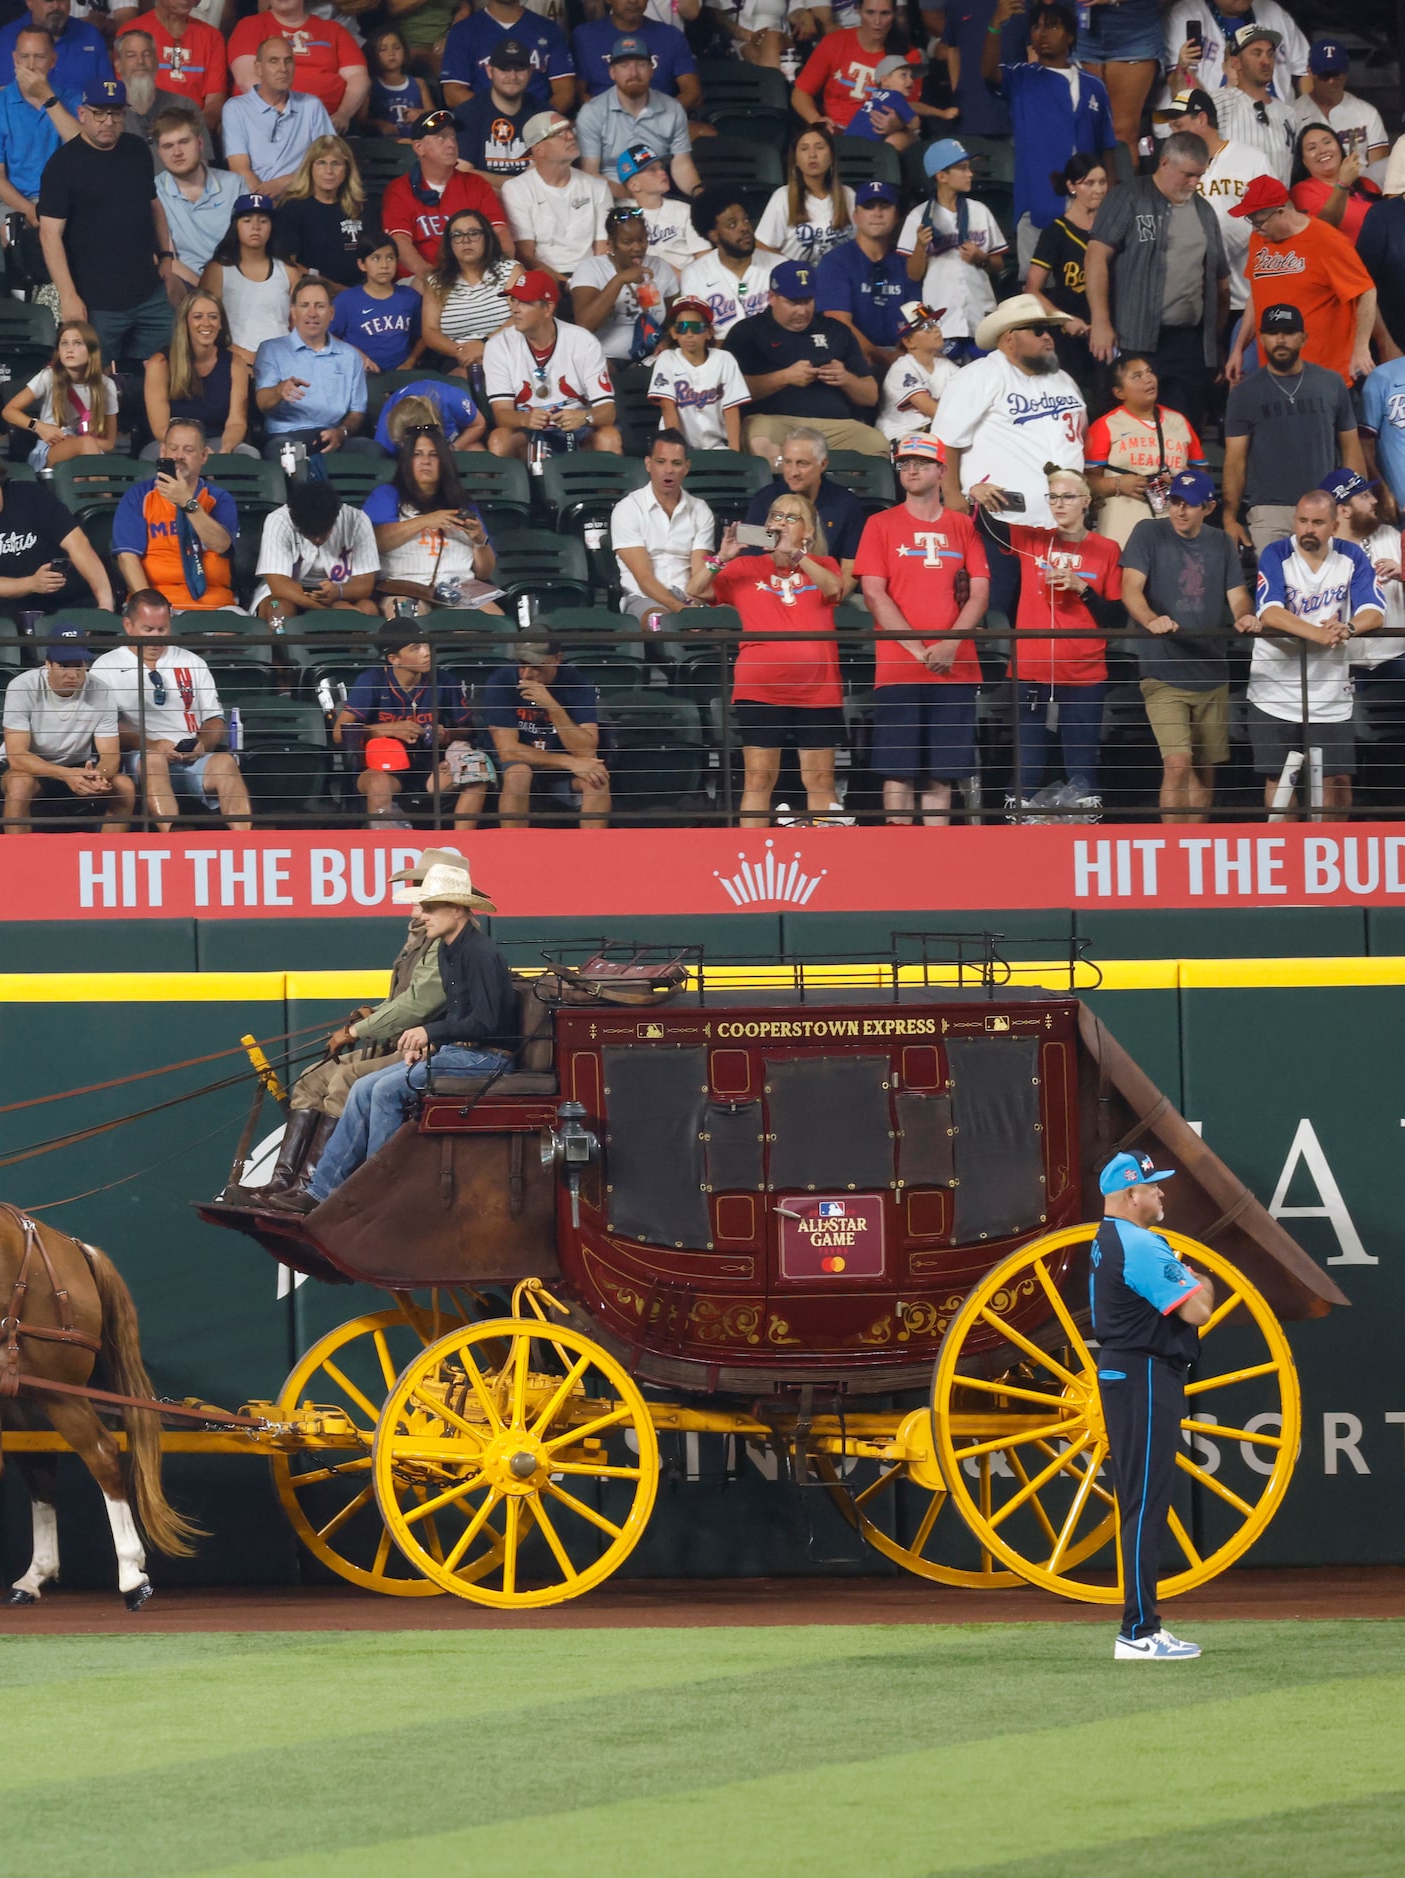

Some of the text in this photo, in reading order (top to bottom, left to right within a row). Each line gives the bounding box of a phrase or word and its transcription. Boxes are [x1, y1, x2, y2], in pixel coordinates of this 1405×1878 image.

[103, 81, 116, 96] T
[1195, 179, 1247, 197] RATE
[249, 195, 263, 208] T
[796, 270, 809, 285] T
[361, 315, 411, 336] TEXAS
[1008, 391, 1082, 426] Dodgers
[150, 521, 178, 538] ME
[914, 532, 949, 568] T
[770, 573, 804, 607] T
[1285, 583, 1348, 618] Brave
[79, 847, 463, 907] HIT THE BUD
[1074, 839, 1166, 896] HIT
[1179, 838, 1287, 895] THE
[717, 1018, 936, 1039] COOPERSTOWN EXPRESS
[810, 1232, 855, 1247] GAME
